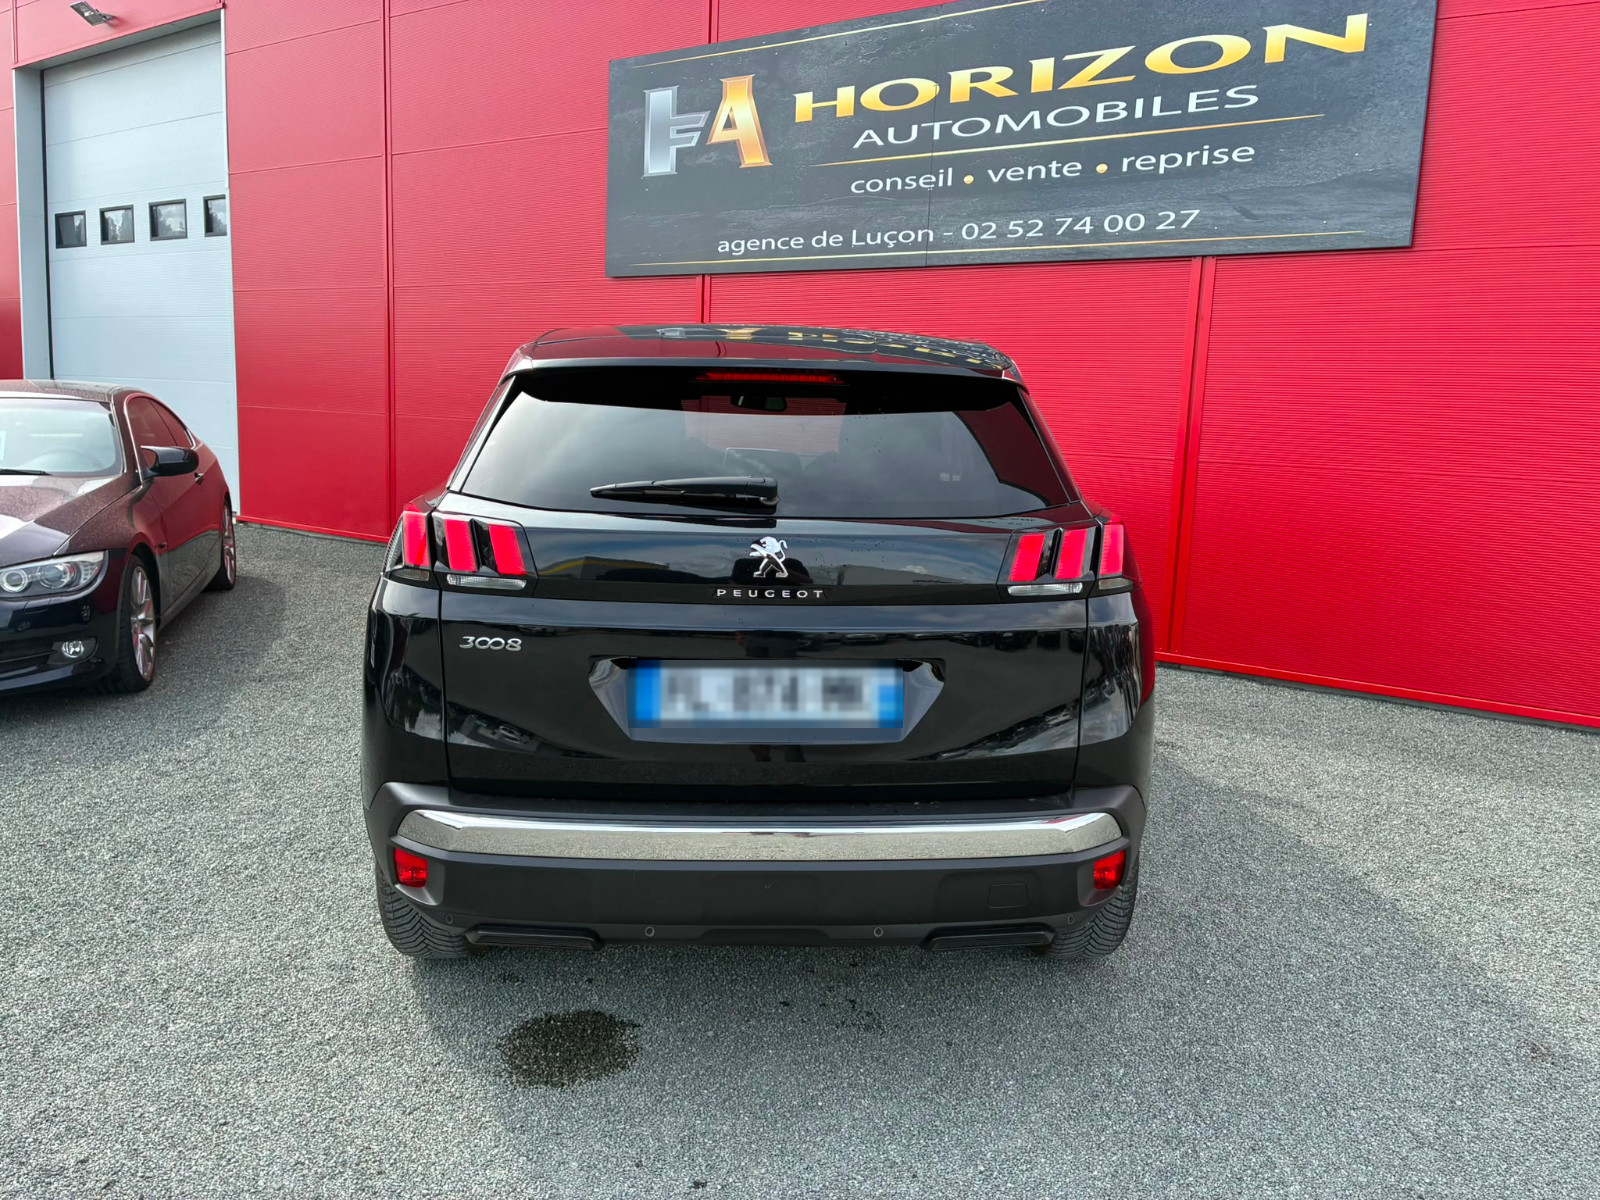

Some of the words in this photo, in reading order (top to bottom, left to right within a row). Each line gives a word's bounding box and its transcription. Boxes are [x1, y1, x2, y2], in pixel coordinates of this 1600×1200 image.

[794, 13, 1367, 122] HORIZON
[853, 85, 1258, 149] AUTOMOBILES
[850, 168, 953, 194] conseil
[987, 159, 1082, 183] vente
[1122, 145, 1255, 174] reprise
[718, 236, 804, 255] agence
[812, 230, 844, 247] de
[852, 228, 934, 247] Luçon
[961, 222, 998, 240] 02
[1007, 220, 1044, 238] 52
[1055, 217, 1094, 235] 74
[1104, 213, 1145, 233] 00
[1156, 210, 1200, 230] 27
[716, 588, 824, 599] PEUGEOT
[459, 636, 522, 652] 3008
